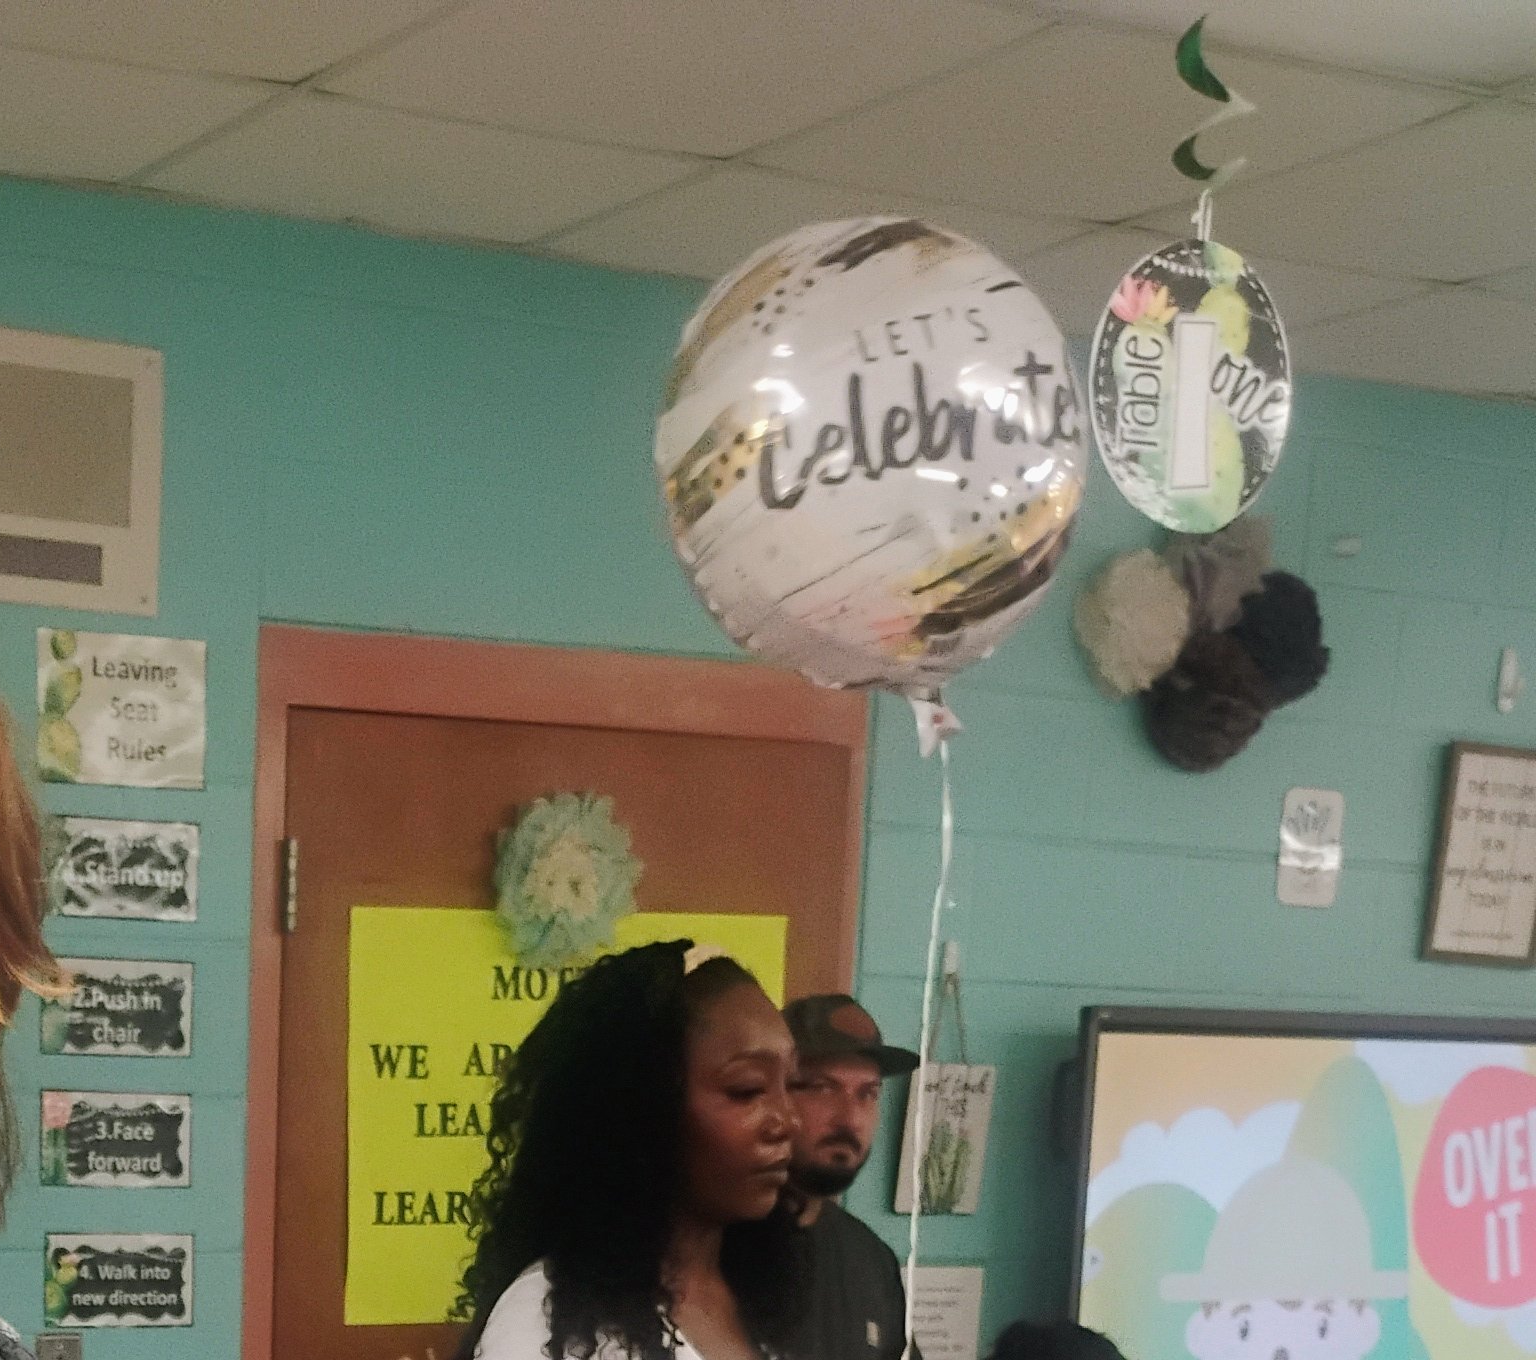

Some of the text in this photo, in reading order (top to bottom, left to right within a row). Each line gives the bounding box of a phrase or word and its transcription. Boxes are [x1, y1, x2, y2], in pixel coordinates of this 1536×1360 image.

[855, 306, 991, 362] LET'S
[1119, 334, 1164, 447] Table
[1210, 352, 1287, 425] one
[91, 655, 178, 689] Leaving
[109, 695, 158, 722] Seat
[106, 736, 167, 761] Rules
[491, 964, 589, 1001] MOT
[92, 1022, 142, 1043] chair
[369, 1043, 430, 1080] WE
[94, 1121, 156, 1142] 3.Face
[414, 1102, 495, 1138] LEA
[87, 1151, 163, 1173] forward
[1483, 1200, 1523, 1284] IT
[98, 1264, 138, 1281] Walk
[140, 1264, 172, 1281] into
[71, 1289, 178, 1307] new direction
